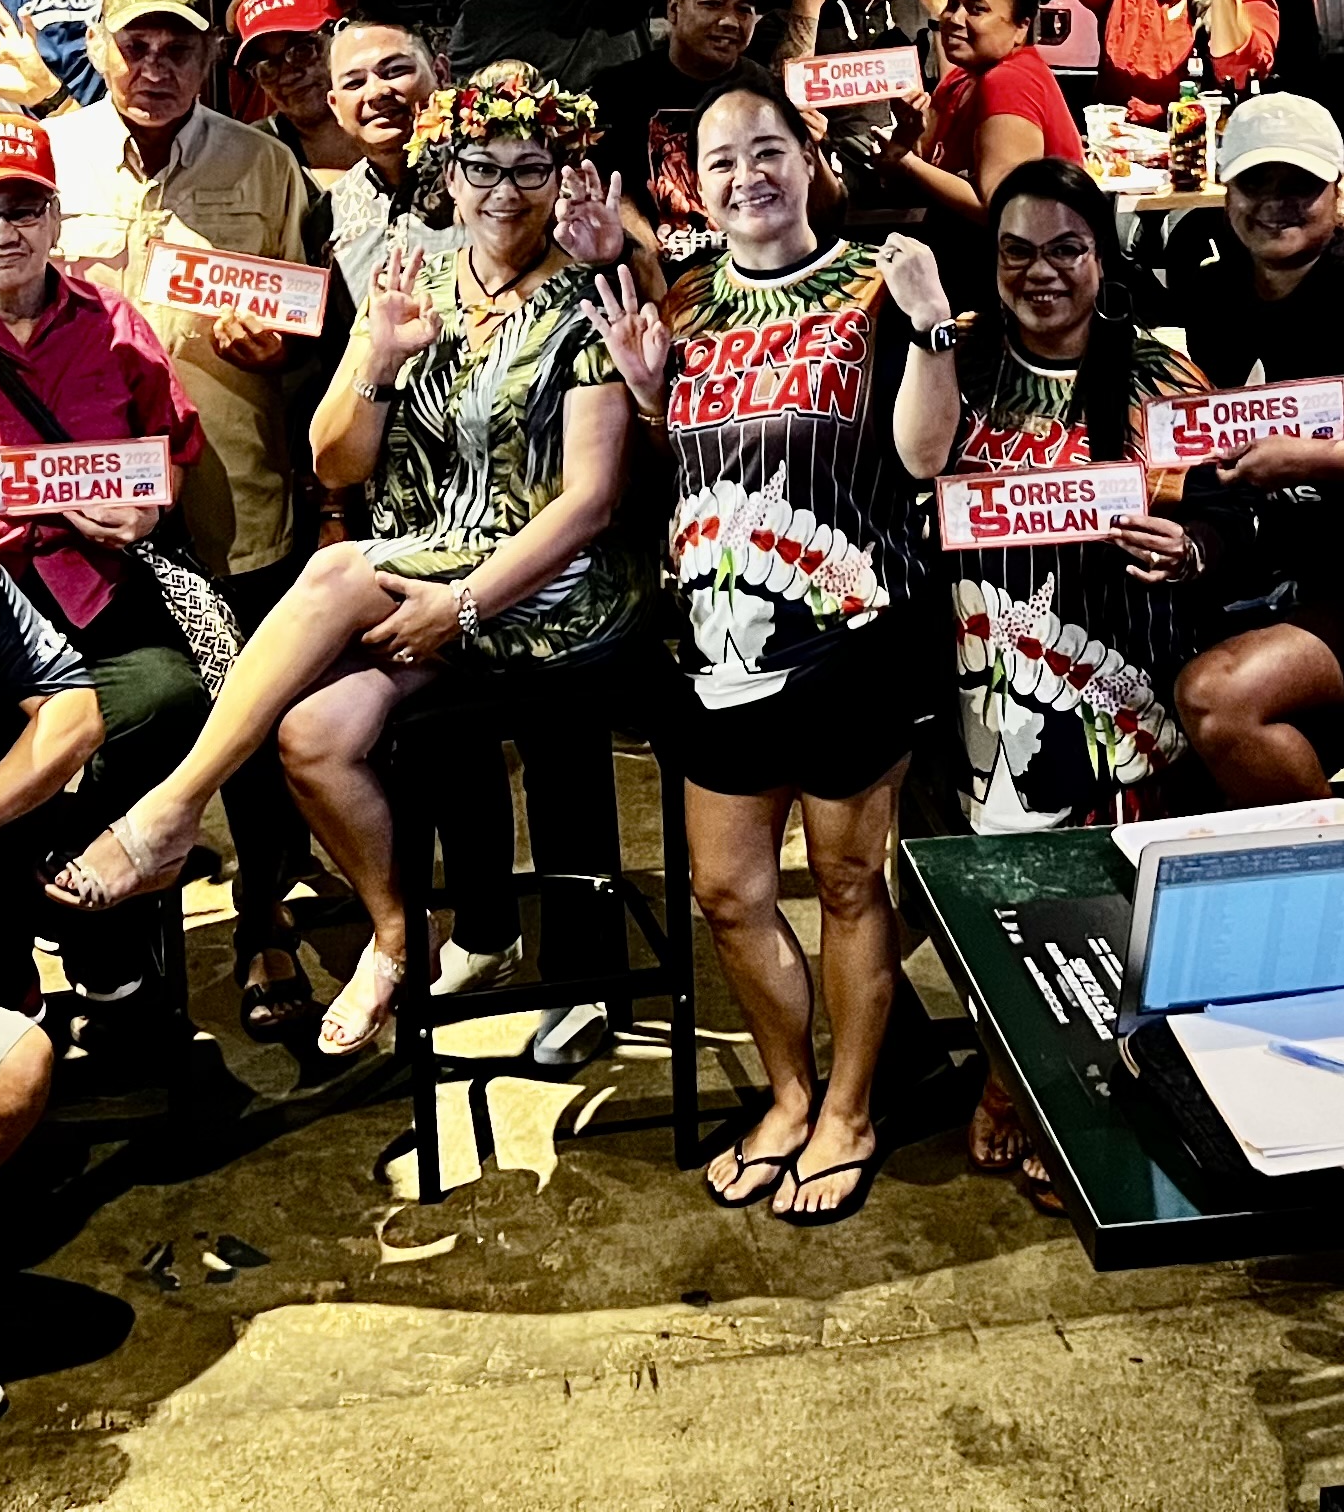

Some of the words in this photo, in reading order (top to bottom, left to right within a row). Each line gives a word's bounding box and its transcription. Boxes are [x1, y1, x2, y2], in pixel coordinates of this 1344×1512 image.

[804, 60, 886, 84] TORRES
[804, 79, 889, 102] SABLAN
[175, 252, 284, 295] TORRES
[683, 308, 870, 380] ORRES
[668, 359, 863, 431] ABLAN
[1171, 396, 1299, 432] TORRES
[1, 452, 122, 483] TORRES
[1, 475, 123, 506] SABLAN
[967, 479, 1096, 512] TORRES
[969, 504, 1098, 538] SABLAN
